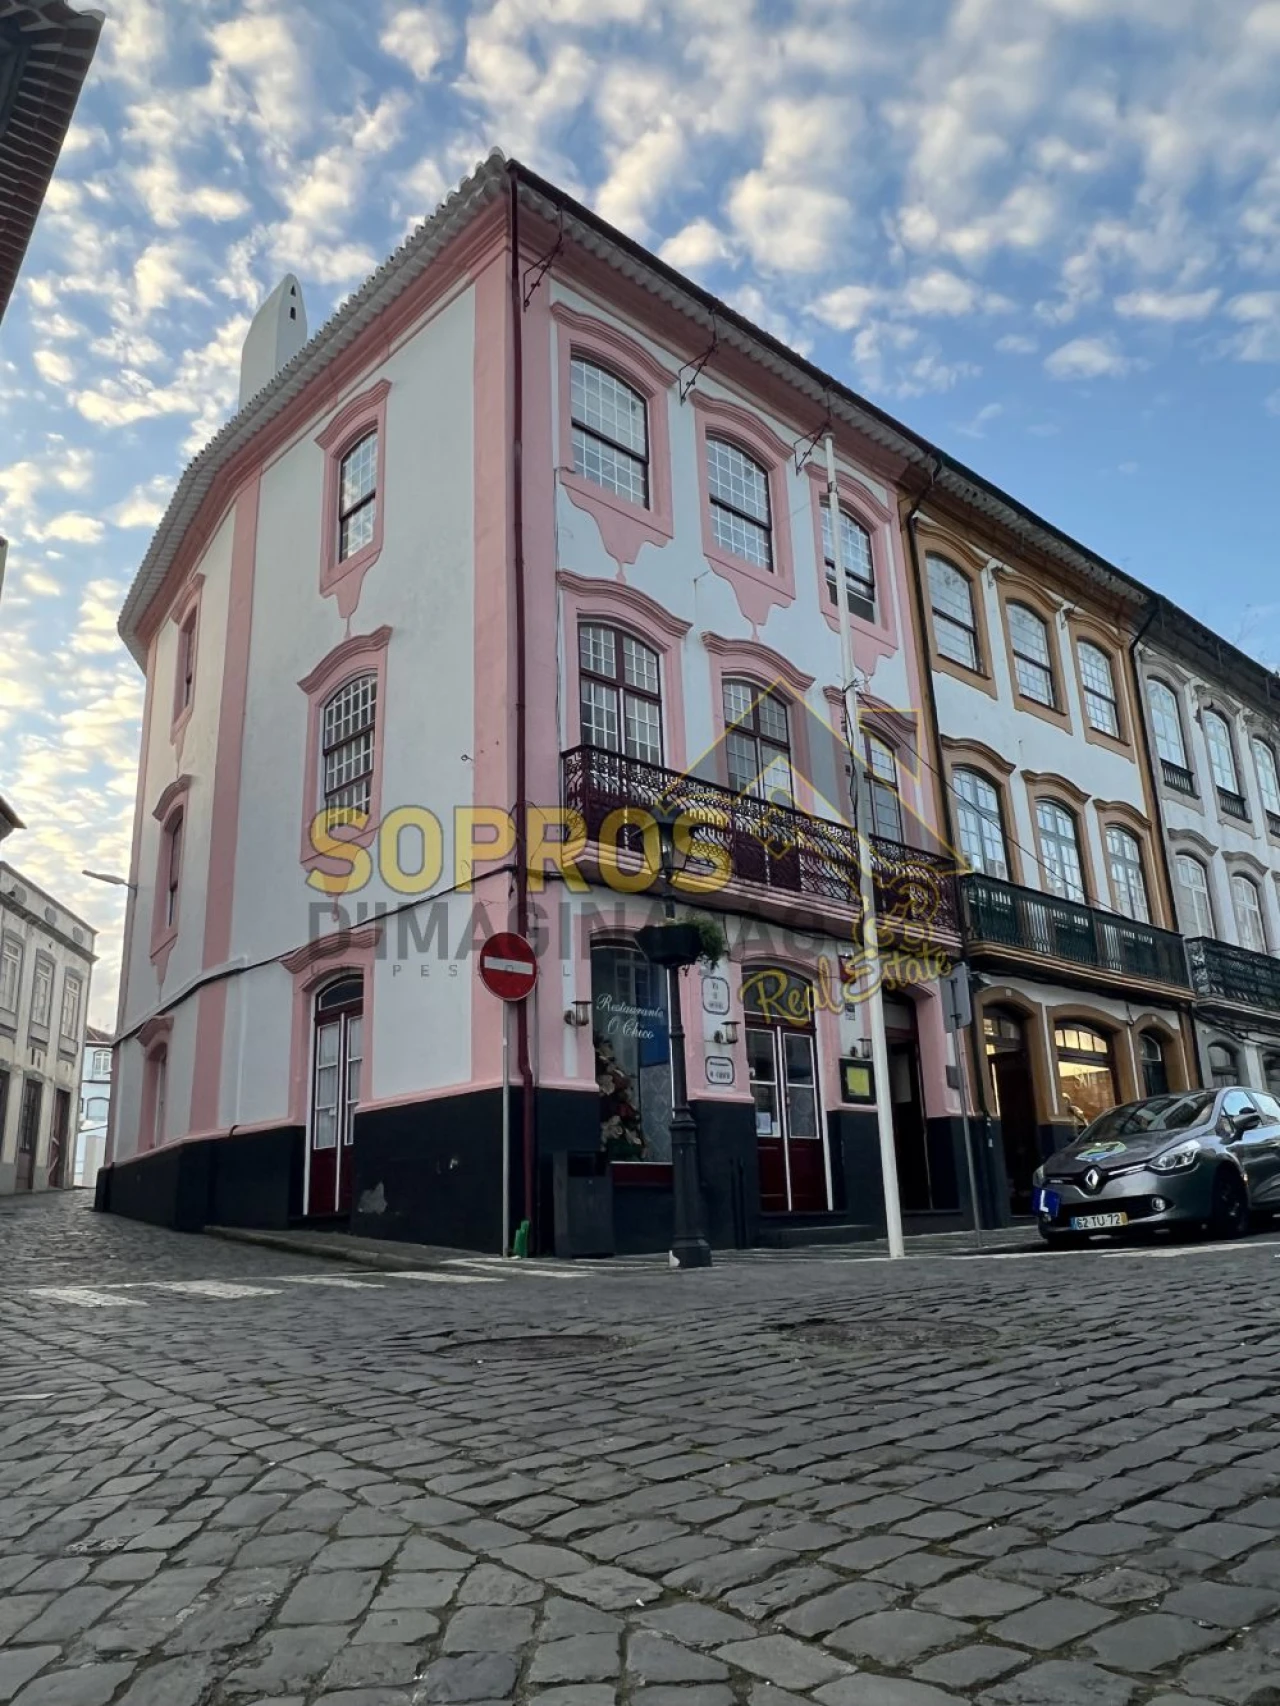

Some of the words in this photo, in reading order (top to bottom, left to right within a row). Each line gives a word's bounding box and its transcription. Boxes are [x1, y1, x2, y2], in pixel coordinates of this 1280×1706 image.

[596, 993, 664, 1018] Restaurante
[607, 1015, 619, 1035] O
[622, 1018, 655, 1040] Chico
[1040, 1189, 1049, 1213] L
